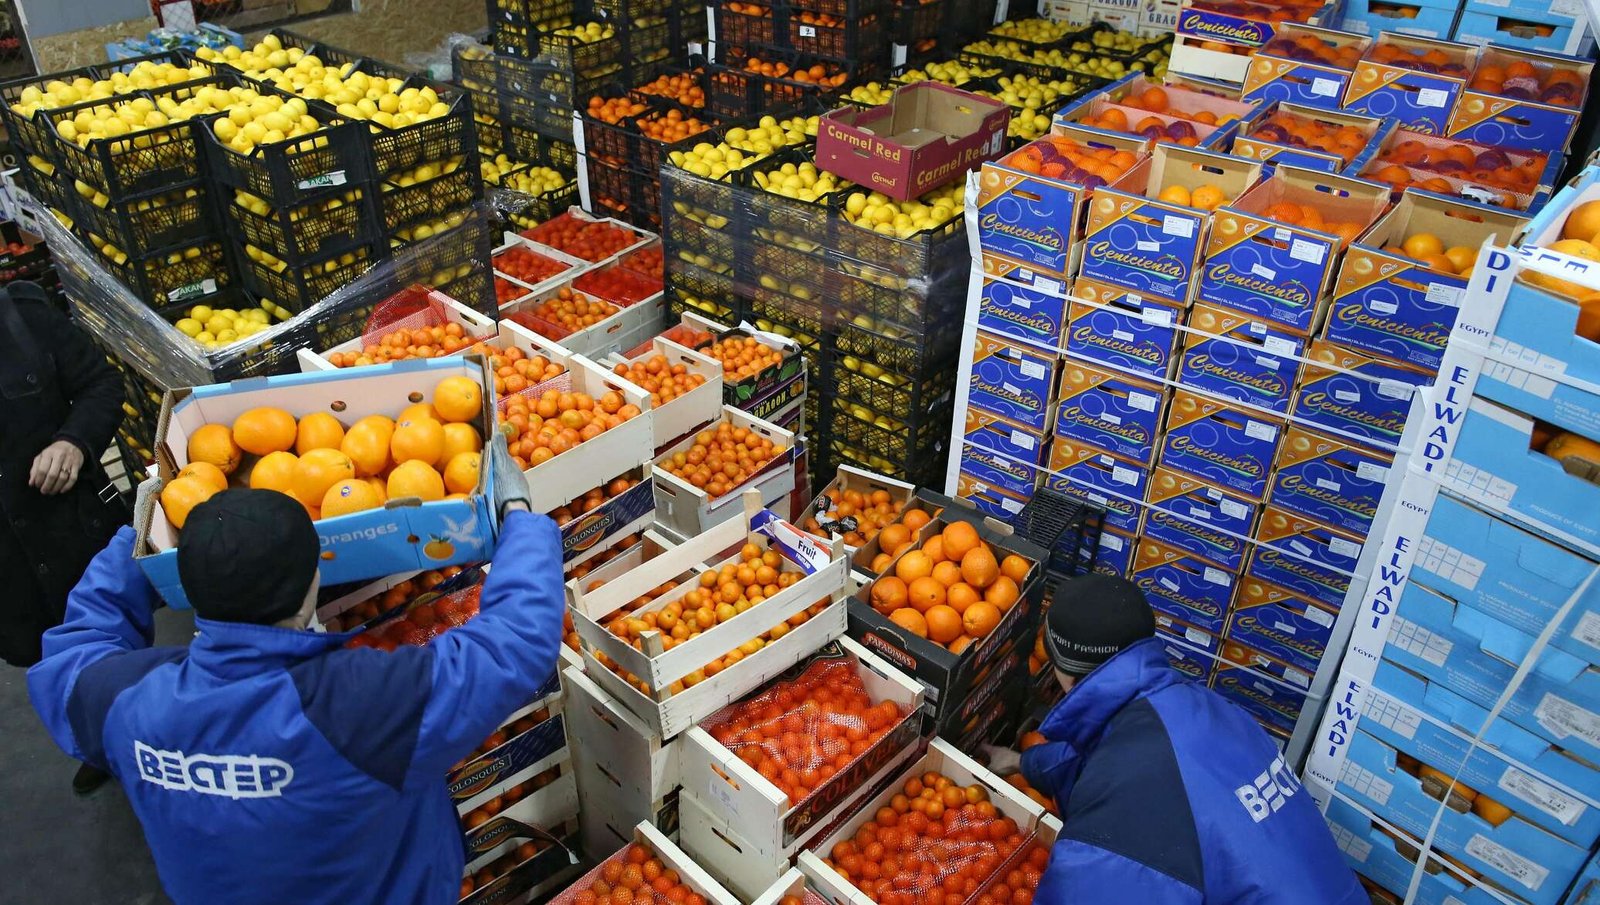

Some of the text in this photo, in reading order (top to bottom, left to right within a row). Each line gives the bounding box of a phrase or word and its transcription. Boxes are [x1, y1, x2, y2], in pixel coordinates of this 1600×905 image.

[1148, 12, 1176, 25] GRAG
[1184, 14, 1259, 41] Cenicienta
[828, 126, 872, 151] Carmel
[876, 144, 901, 162] Red
[916, 151, 962, 187] Carmel
[980, 213, 1061, 249] Cenicienta
[1090, 241, 1182, 278] Cenicienta
[1208, 264, 1307, 303] Cenicienta
[980, 298, 1053, 333] Cenicienta
[1337, 303, 1449, 347] Cenicienta
[1459, 322, 1490, 338] EGYPT
[1073, 326, 1161, 362] Cenicienta
[970, 374, 1039, 410] Cenicienta
[1187, 354, 1283, 397] Cenicienta
[1063, 406, 1147, 443] Cenicienta
[1303, 392, 1405, 434] Cenicienta
[1423, 365, 1470, 473] ELWADI
[962, 444, 1030, 479] Cenicnta
[1170, 435, 1261, 476] Cenicienta
[1052, 478, 1133, 515] Ceninta
[1280, 475, 1376, 518] Cenicienta
[1401, 500, 1429, 516] EGYPT
[320, 522, 398, 547] Oranges
[563, 515, 612, 550] COLONQUES
[1151, 510, 1237, 551] Cenicienta
[798, 539, 817, 560] Fruit
[1258, 550, 1350, 593] Cenicienta
[1371, 535, 1411, 630] ELWADI
[1136, 577, 1219, 616] Cenicienta
[1074, 643, 1119, 654] FASHION
[1237, 616, 1324, 659] Cenicienta
[1353, 646, 1378, 662] EGYPT
[1328, 680, 1362, 758] ELWADI
[135, 742, 293, 798] ВЕСТЕР
[1312, 769, 1335, 785] EGYPT
